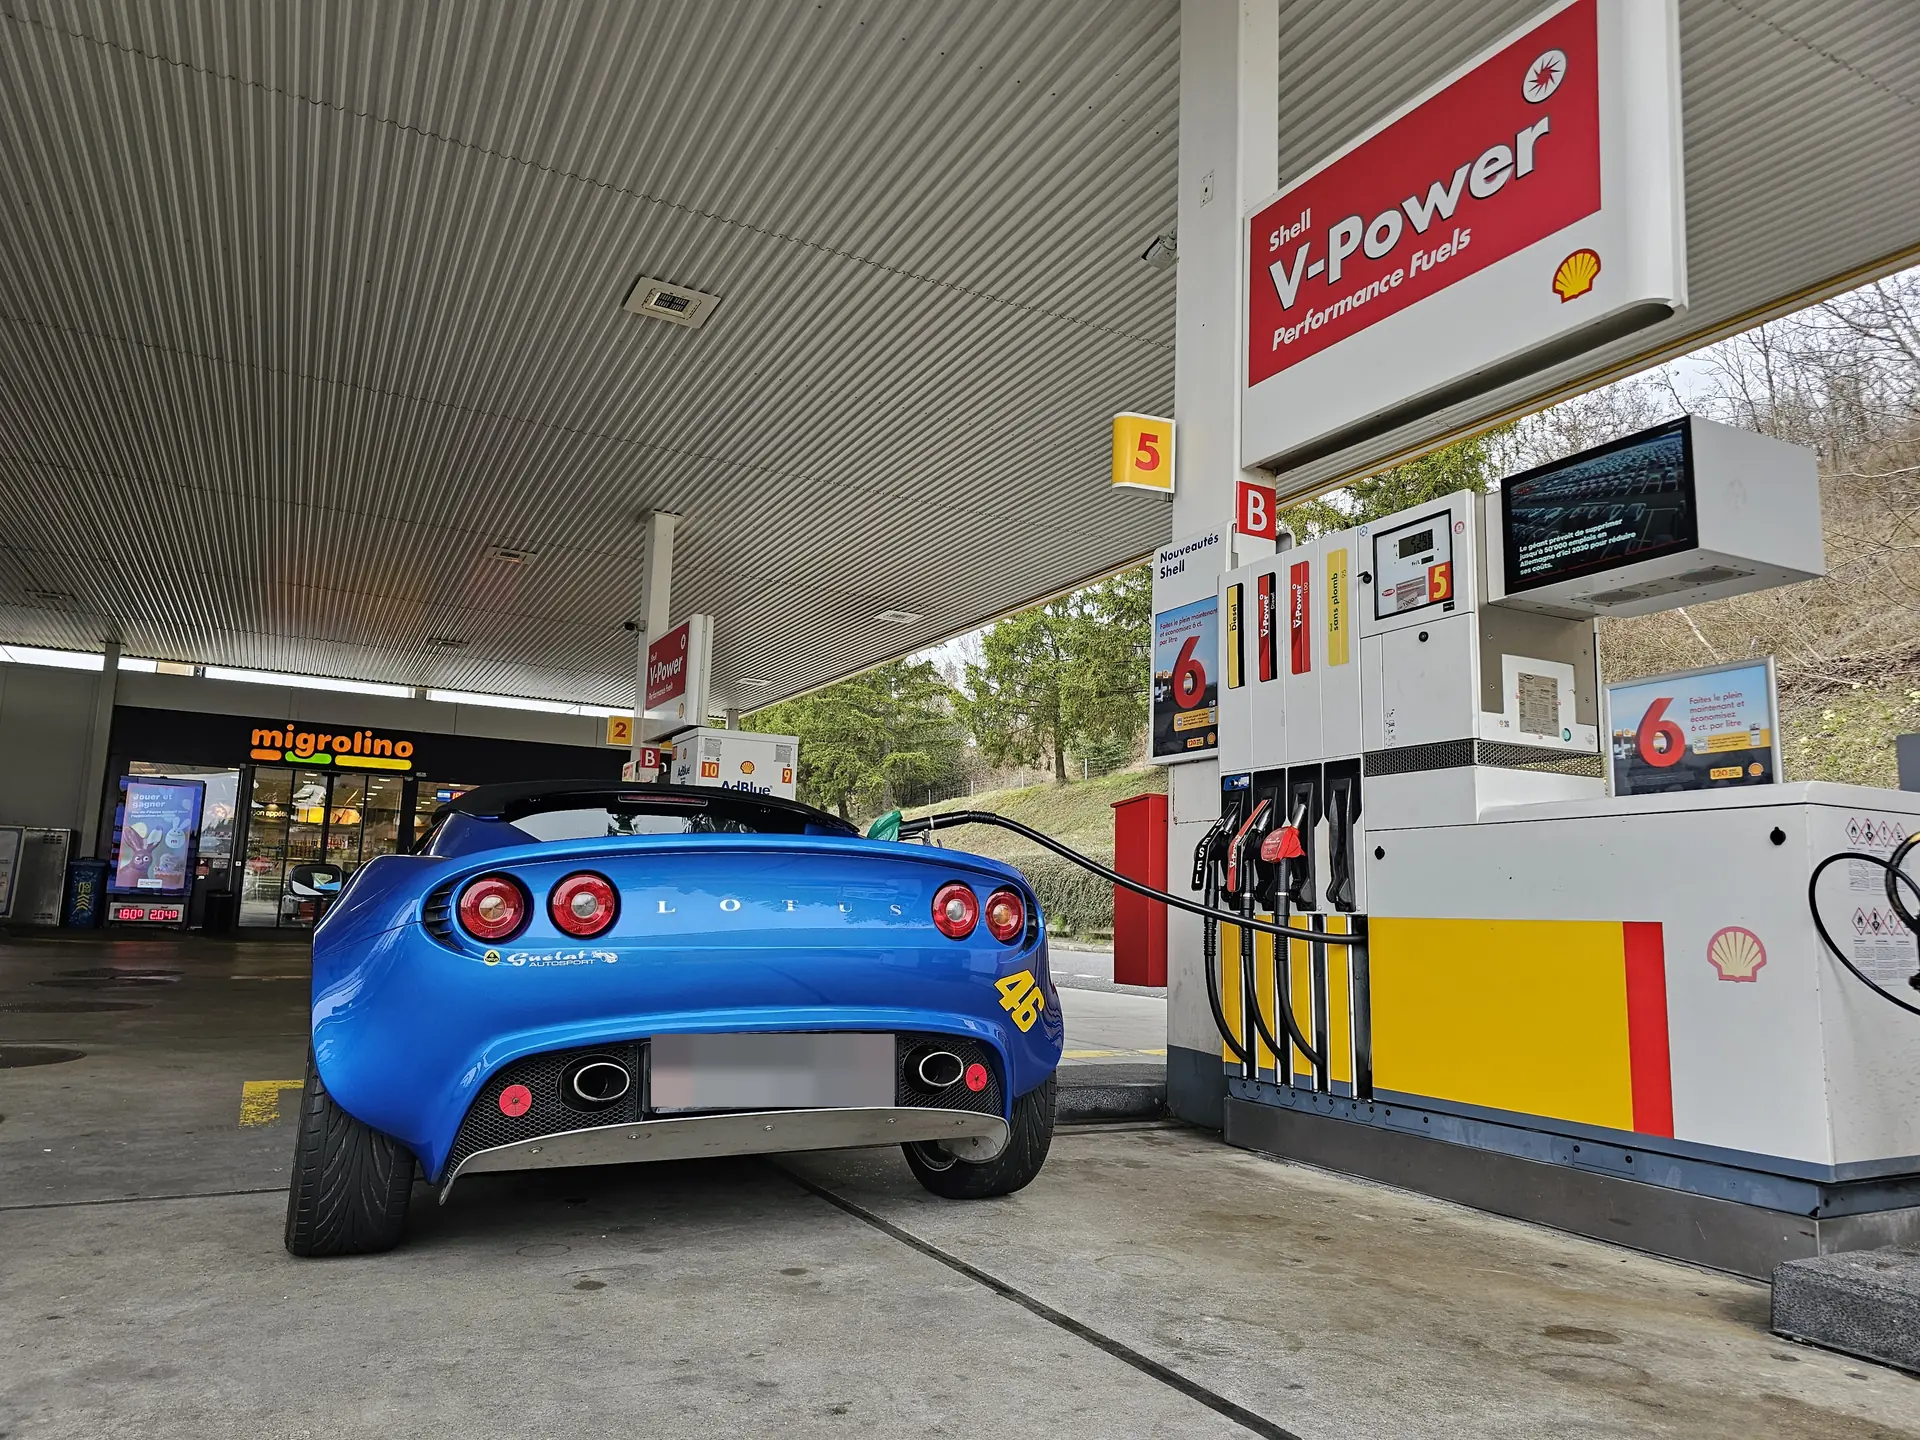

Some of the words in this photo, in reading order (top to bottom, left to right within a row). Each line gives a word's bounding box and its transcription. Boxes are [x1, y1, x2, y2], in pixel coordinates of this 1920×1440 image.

[1268, 116, 1551, 311] V-Power
[1269, 207, 1311, 252] Shell
[1272, 268, 1404, 351] Performance
[1409, 228, 1472, 279] Fuels
[1134, 432, 1160, 471] 5
[1247, 489, 1267, 532] B
[1160, 533, 1219, 564] Nouveautés
[1528, 540, 1548, 552] géant
[1549, 532, 1574, 546] prévoit
[1585, 519, 1623, 534] supprimer
[1568, 535, 1597, 548] emplois
[1520, 554, 1555, 567] Allemagne
[1571, 544, 1589, 554] 2030
[1590, 539, 1608, 550] pour
[1608, 532, 1637, 544] réduire
[1160, 559, 1185, 580] Shell
[1433, 565, 1447, 599] 5
[1332, 573, 1340, 605] plomb
[1160, 619, 1173, 629] Faites
[1178, 615, 1191, 626] plein
[1191, 608, 1218, 622] maintenant
[1165, 624, 1192, 636] économisez
[1192, 621, 1196, 629] 6
[1159, 639, 1168, 647] par
[650, 656, 683, 687] V-Power
[1173, 635, 1206, 709] 6
[1689, 695, 1712, 705] Faites
[1713, 693, 1721, 702] le
[1723, 691, 1743, 703] plein
[1690, 702, 1735, 713] maintenant
[1736, 700, 1745, 708] et
[614, 721, 627, 738] 2
[1690, 711, 1737, 723] économisez
[1710, 722, 1724, 732] par
[1725, 719, 1742, 727] litre
[251, 723, 414, 758] migrolino
[1636, 697, 1686, 768] 6
[645, 749, 655, 766] B
[704, 763, 717, 777] 10
[783, 769, 791, 783] 9
[132, 801, 166, 809] gagner
[133, 793, 161, 801] Jouer
[1195, 818, 1224, 884] DIESEL
[529, 959, 596, 967] AUTOSPORT
[993, 969, 1045, 1033] 46
